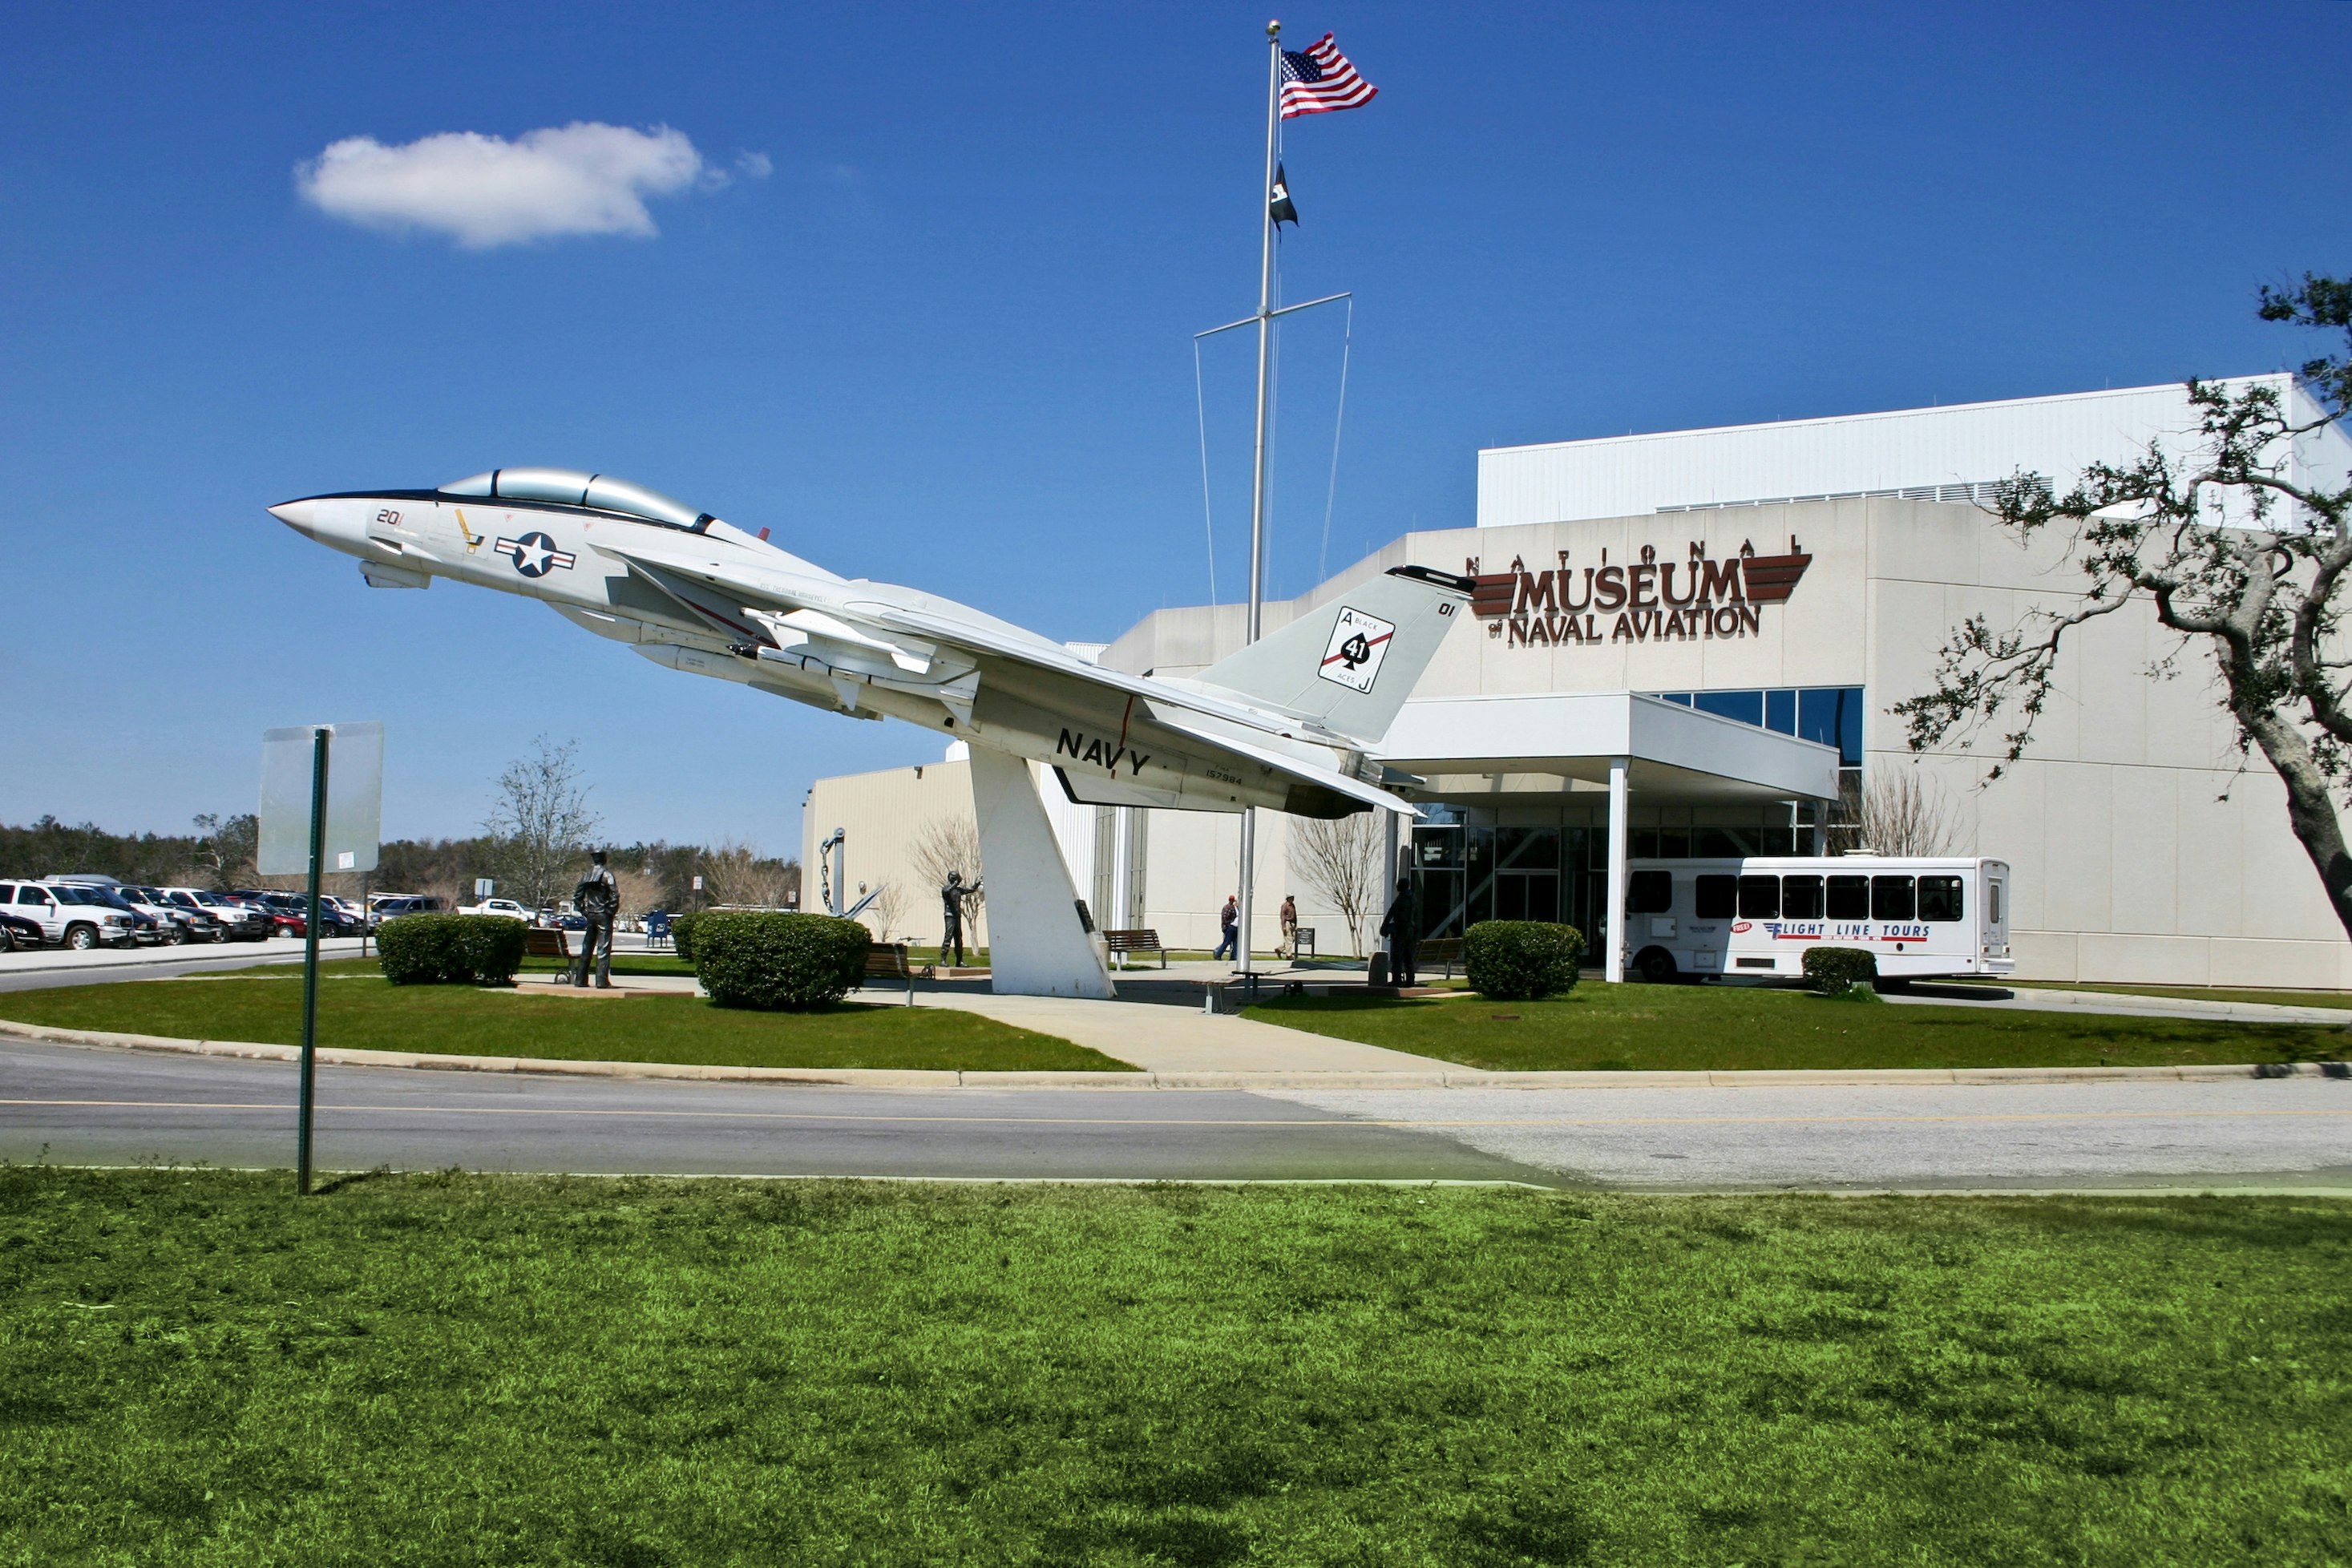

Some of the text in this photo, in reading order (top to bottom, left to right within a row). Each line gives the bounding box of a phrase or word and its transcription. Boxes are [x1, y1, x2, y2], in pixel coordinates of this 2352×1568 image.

[1466, 535, 1800, 574] NATIONAL
[1514, 559, 1744, 614] MUSEUM
[1439, 603, 1455, 617] 01
[1340, 612, 1352, 626] A
[1355, 617, 1378, 630] BLACK
[1508, 615, 1603, 644] NAVAL
[1612, 605, 1761, 640] AVIATION
[1346, 640, 1366, 659] 41
[1337, 673, 1355, 684] ACES
[1056, 727, 1151, 776] NAVY
[1206, 770, 1242, 785] 157984
[1772, 923, 1825, 940] FLIGHT
[1837, 924, 1870, 936] LINE
[1884, 925, 1930, 937] TOURS
